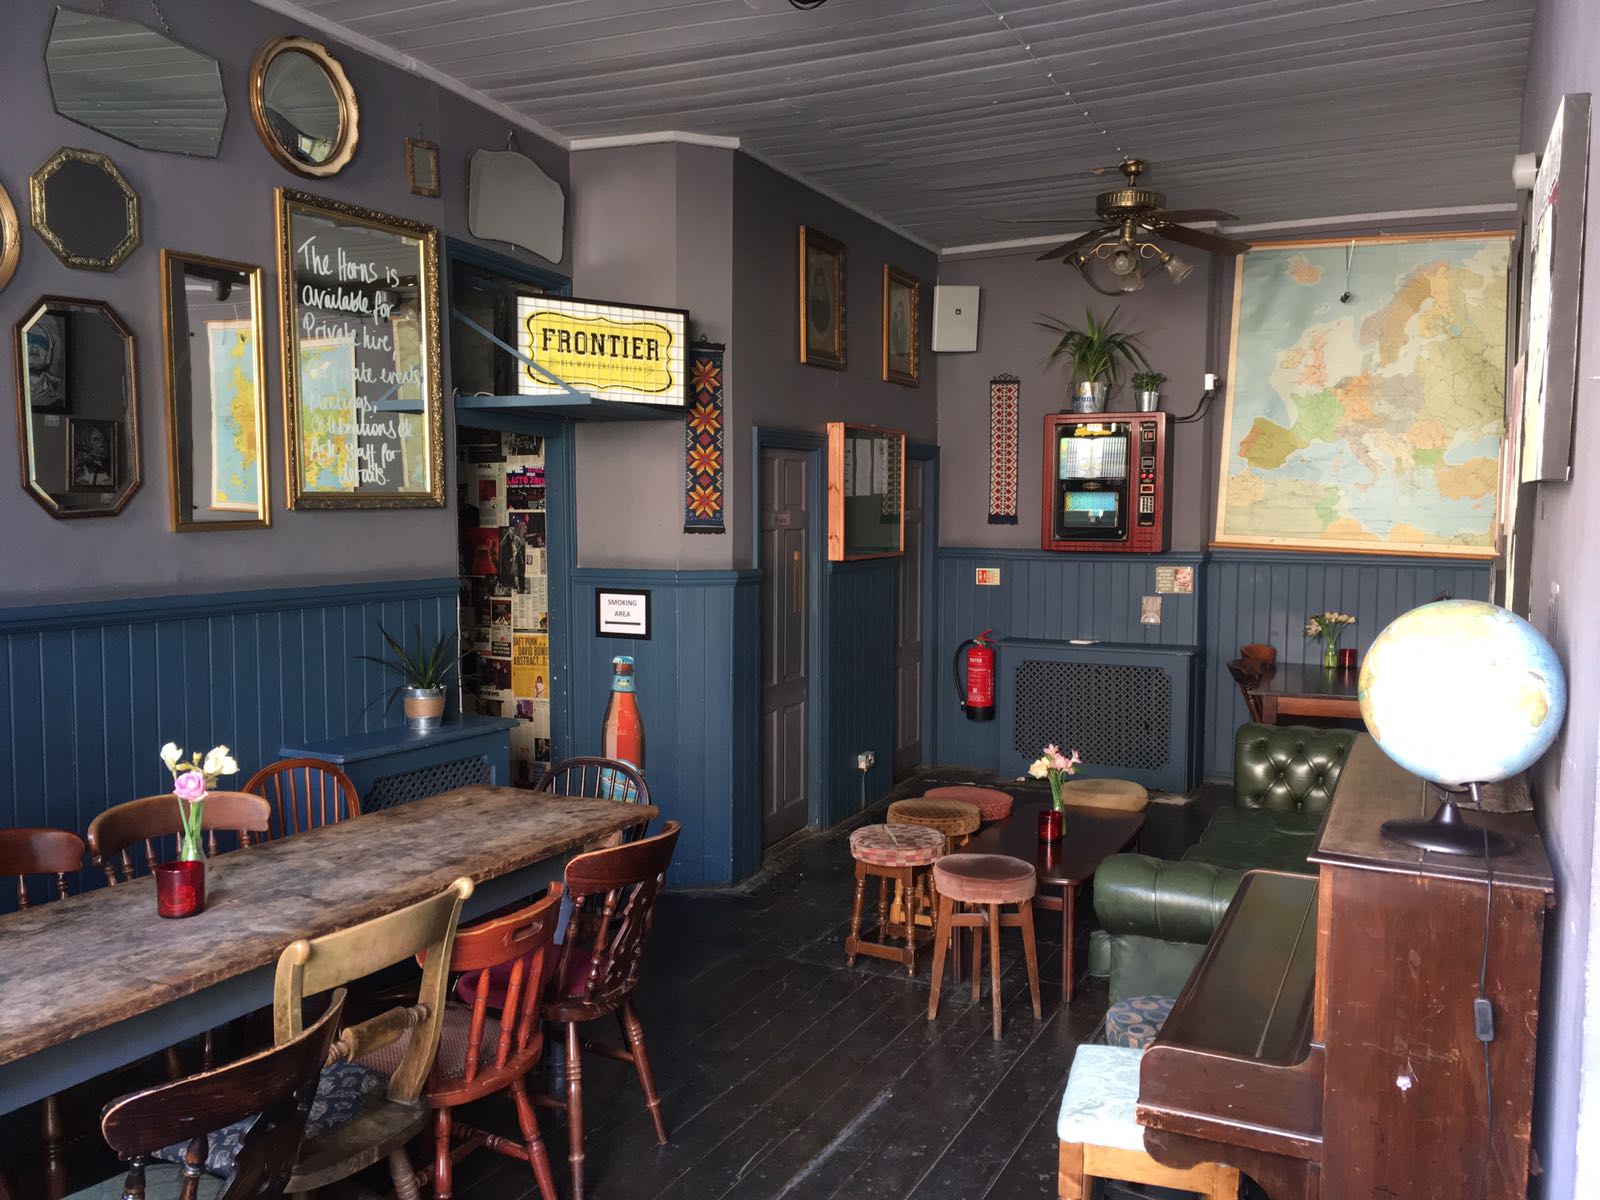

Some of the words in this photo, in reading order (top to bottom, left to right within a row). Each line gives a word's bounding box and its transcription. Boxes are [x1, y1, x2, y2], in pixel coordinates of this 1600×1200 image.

[298, 235, 333, 276] The
[338, 247, 378, 284] Horns
[385, 266, 400, 288] is
[373, 290, 396, 326] for
[303, 312, 361, 347] Private
[542, 327, 660, 362] FRONTIER
[381, 442, 402, 469] for
[607, 598, 638, 607] SMOKING
[614, 610, 631, 618] AREA
